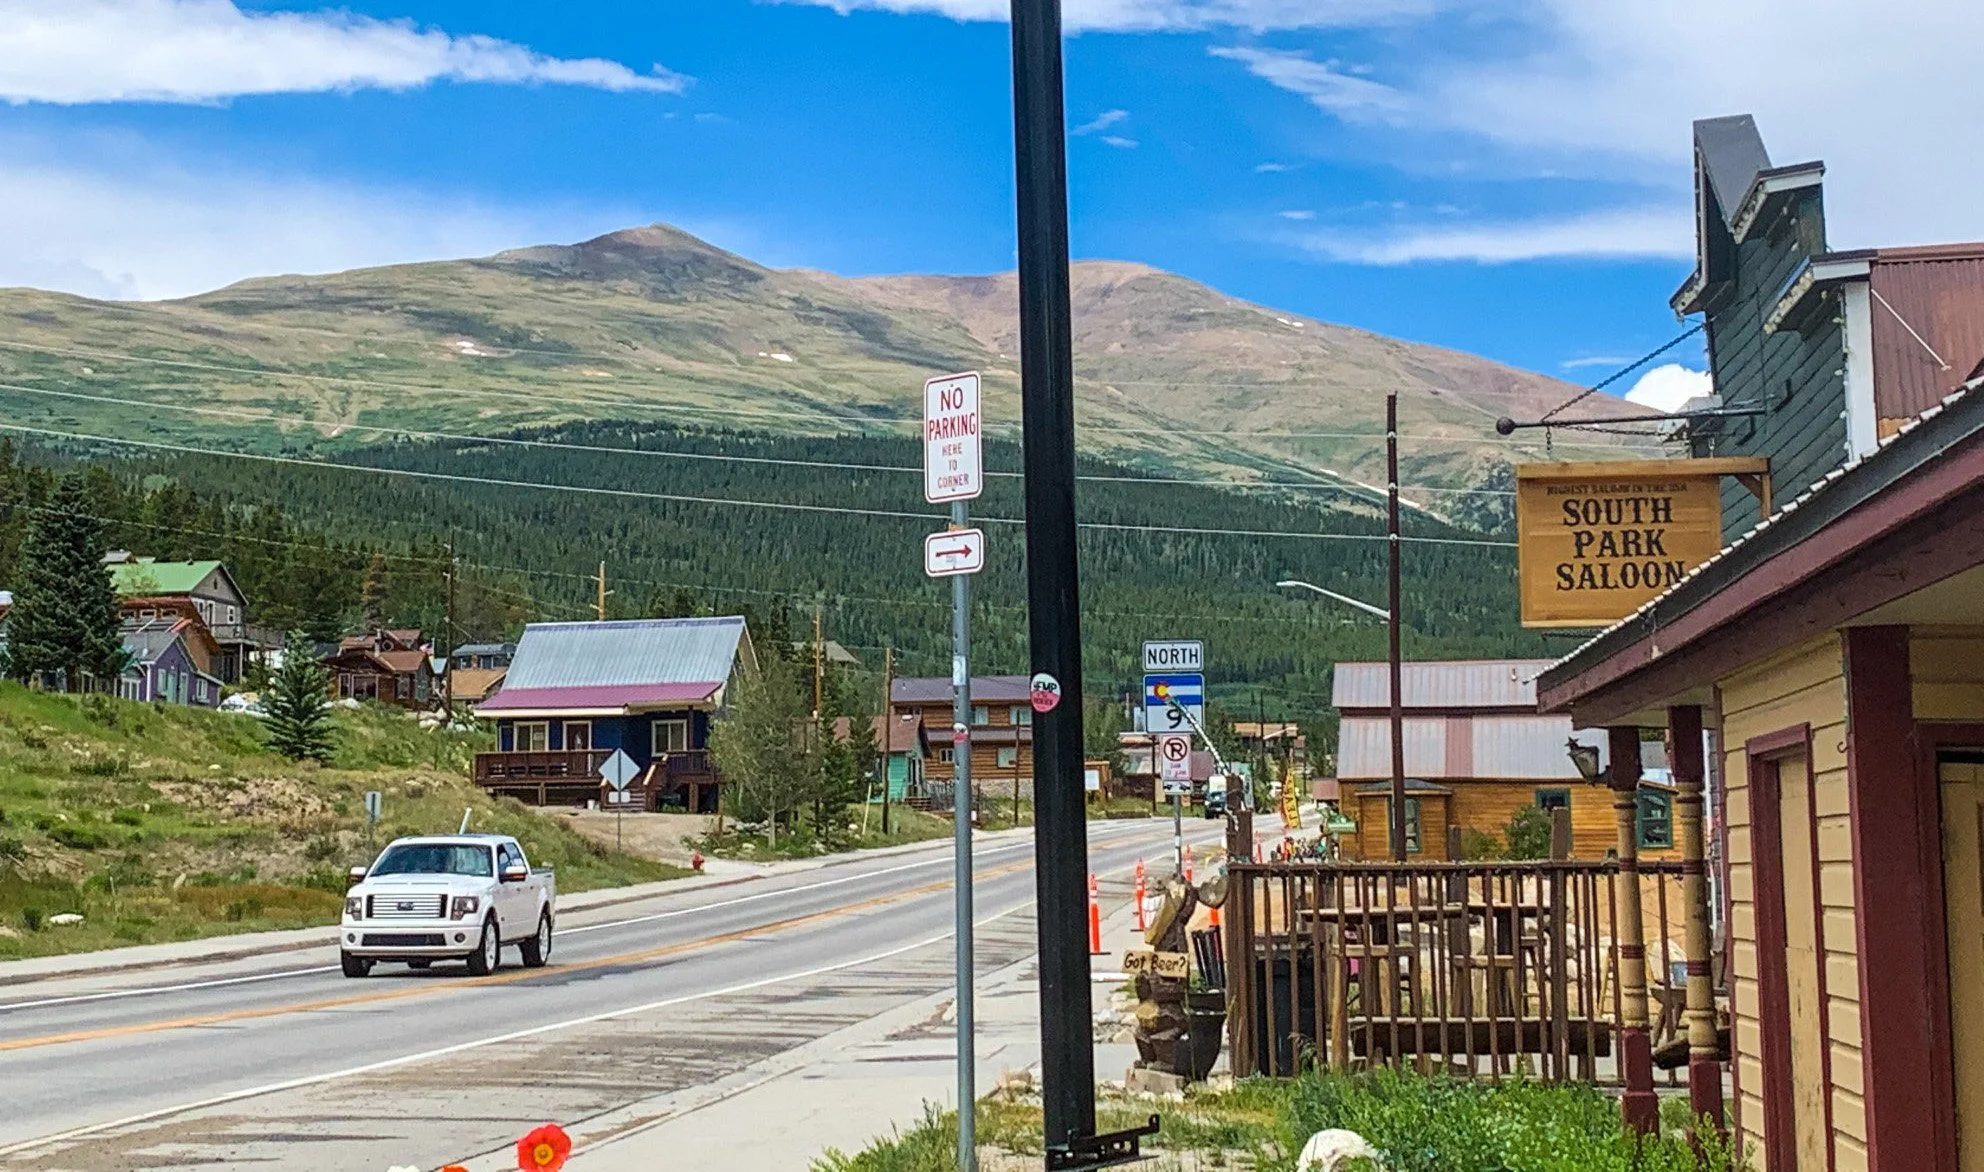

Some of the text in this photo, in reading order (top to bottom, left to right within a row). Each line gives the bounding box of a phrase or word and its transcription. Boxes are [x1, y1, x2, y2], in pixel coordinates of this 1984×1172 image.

[940, 387, 964, 411] NO
[928, 413, 976, 441] PARKING
[942, 443, 963, 457] HERE
[948, 458, 957, 471] TO
[937, 473, 970, 489] CORNER
[1562, 496, 1673, 527] SOUTH
[1572, 528, 1668, 559] PARK
[1556, 560, 1686, 591] SALOON
[1147, 648, 1199, 665] NORTH
[1166, 708, 1182, 729] 9
[1124, 952, 1186, 972] Got Beer?
